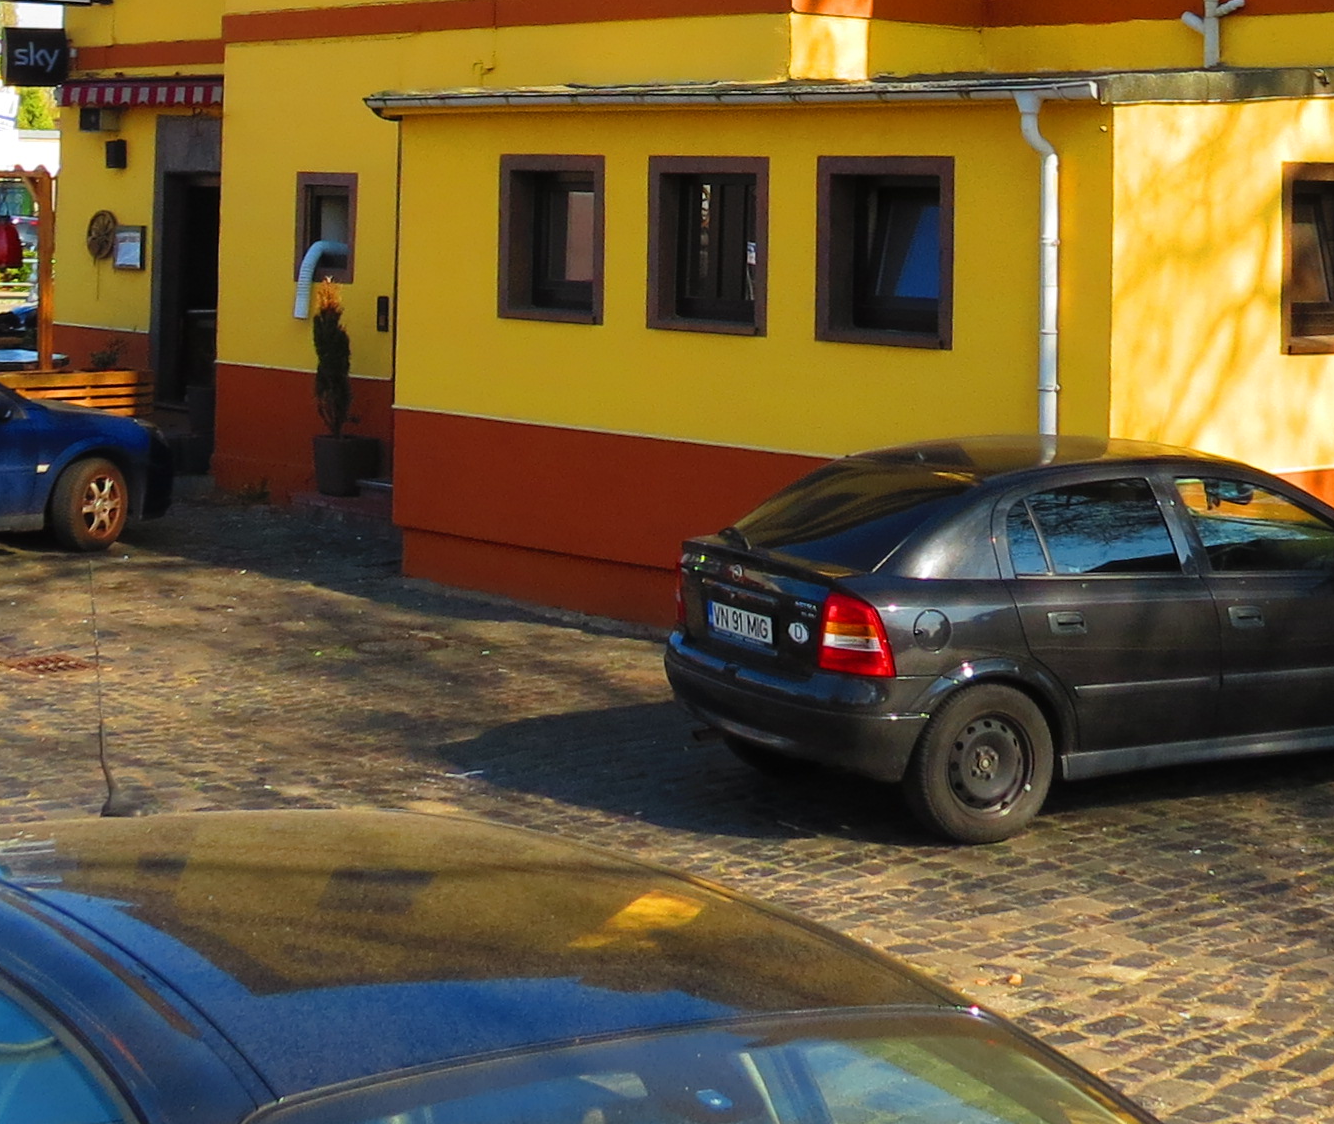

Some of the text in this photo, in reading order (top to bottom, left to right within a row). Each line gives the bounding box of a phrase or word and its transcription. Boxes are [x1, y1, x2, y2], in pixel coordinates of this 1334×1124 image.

[14, 41, 60, 72] sky
[713, 605, 768, 640] VN 91 MIG
[794, 624, 803, 639] D
